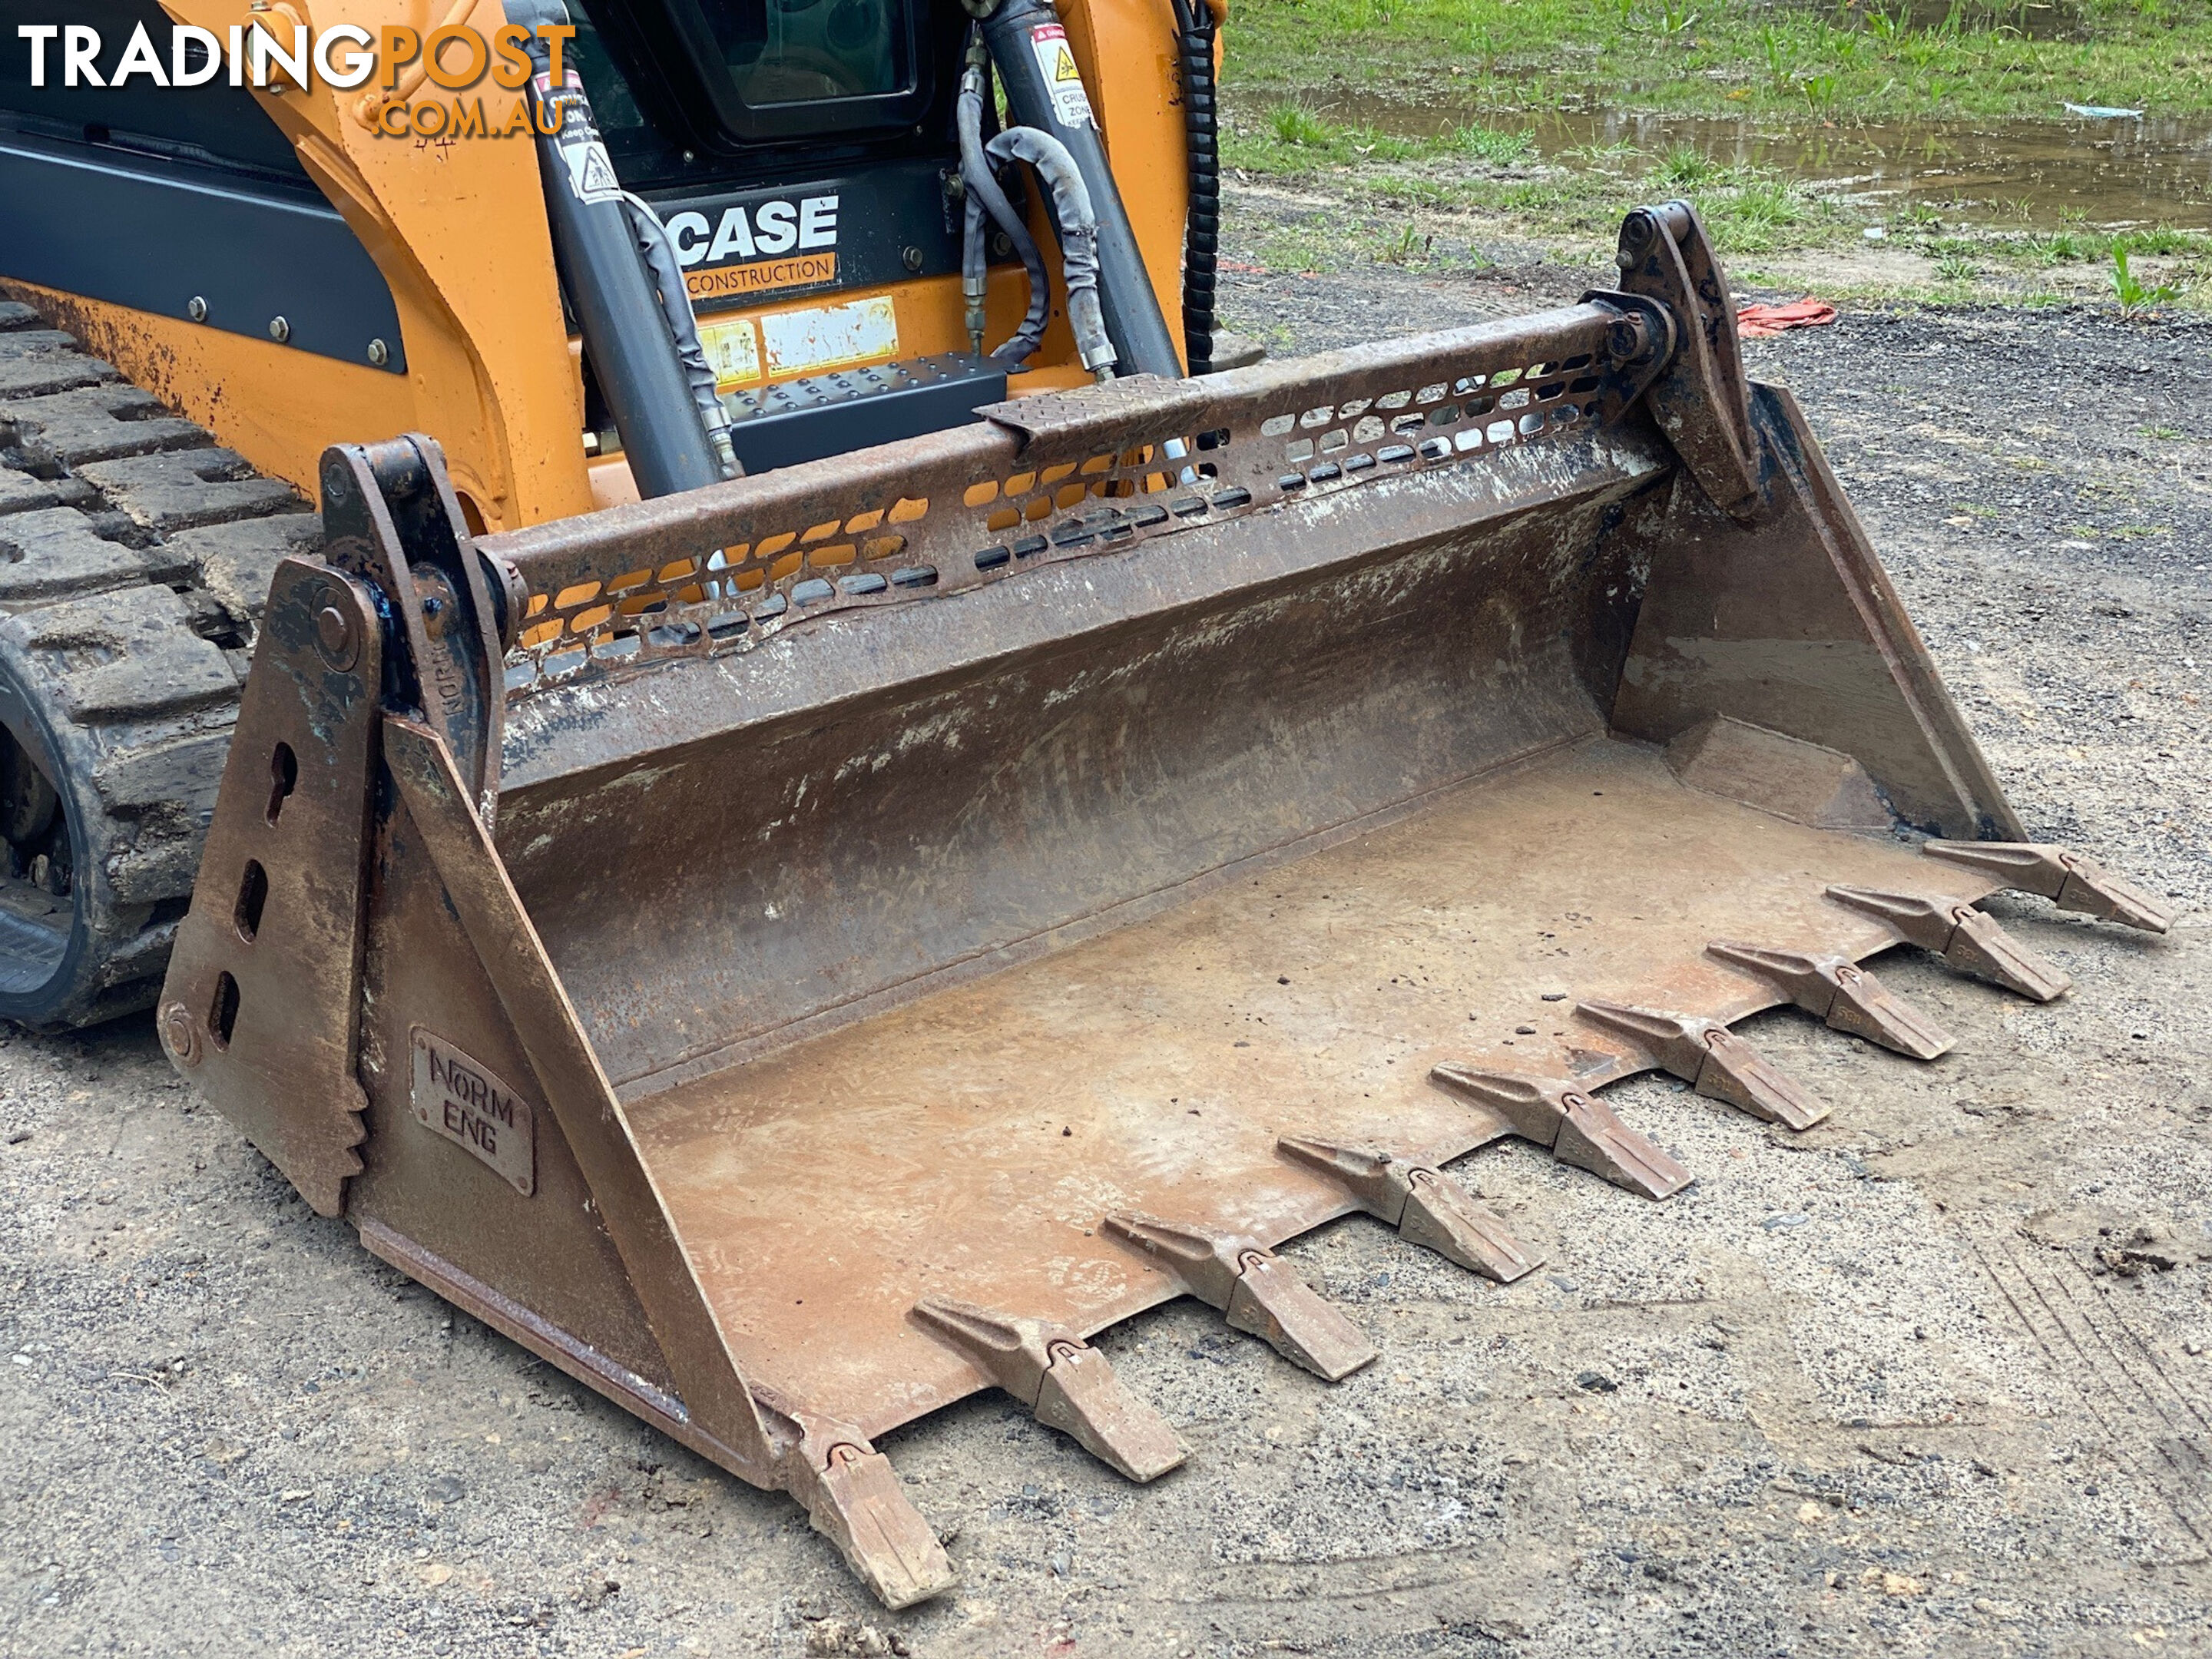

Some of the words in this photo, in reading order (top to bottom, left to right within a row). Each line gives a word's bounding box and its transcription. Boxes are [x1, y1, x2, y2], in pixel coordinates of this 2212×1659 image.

[664, 195, 839, 267] CASE
[687, 259, 830, 294] CONSTRUCTION
[429, 1047, 515, 1128] NORM
[443, 1099, 497, 1154] ENG
